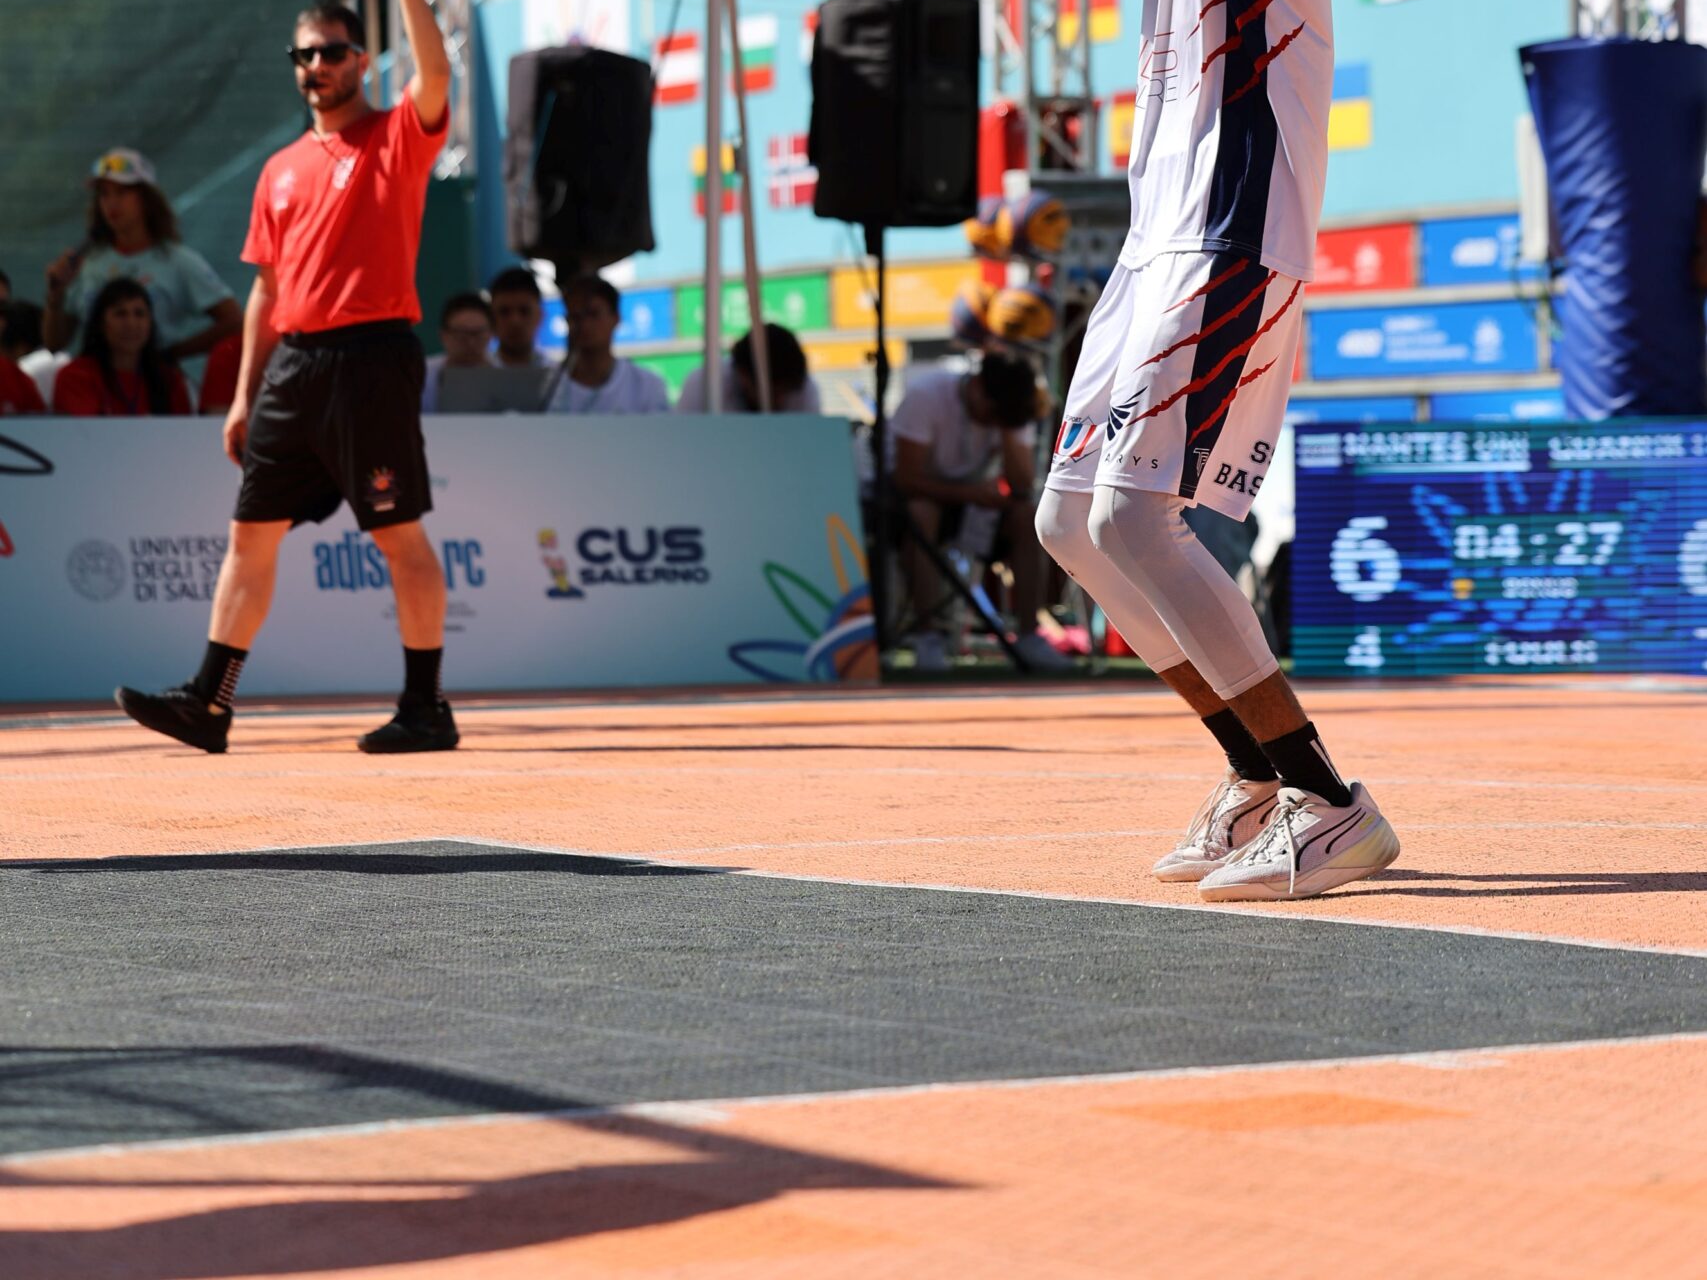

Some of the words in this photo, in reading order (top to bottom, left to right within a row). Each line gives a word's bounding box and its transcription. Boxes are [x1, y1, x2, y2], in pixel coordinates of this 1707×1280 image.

[576, 526, 705, 565] CUS
[1329, 516, 1402, 602] 6
[133, 560, 195, 580] DEGLI
[579, 567, 710, 586] SALERNO
[135, 581, 158, 602] DI
